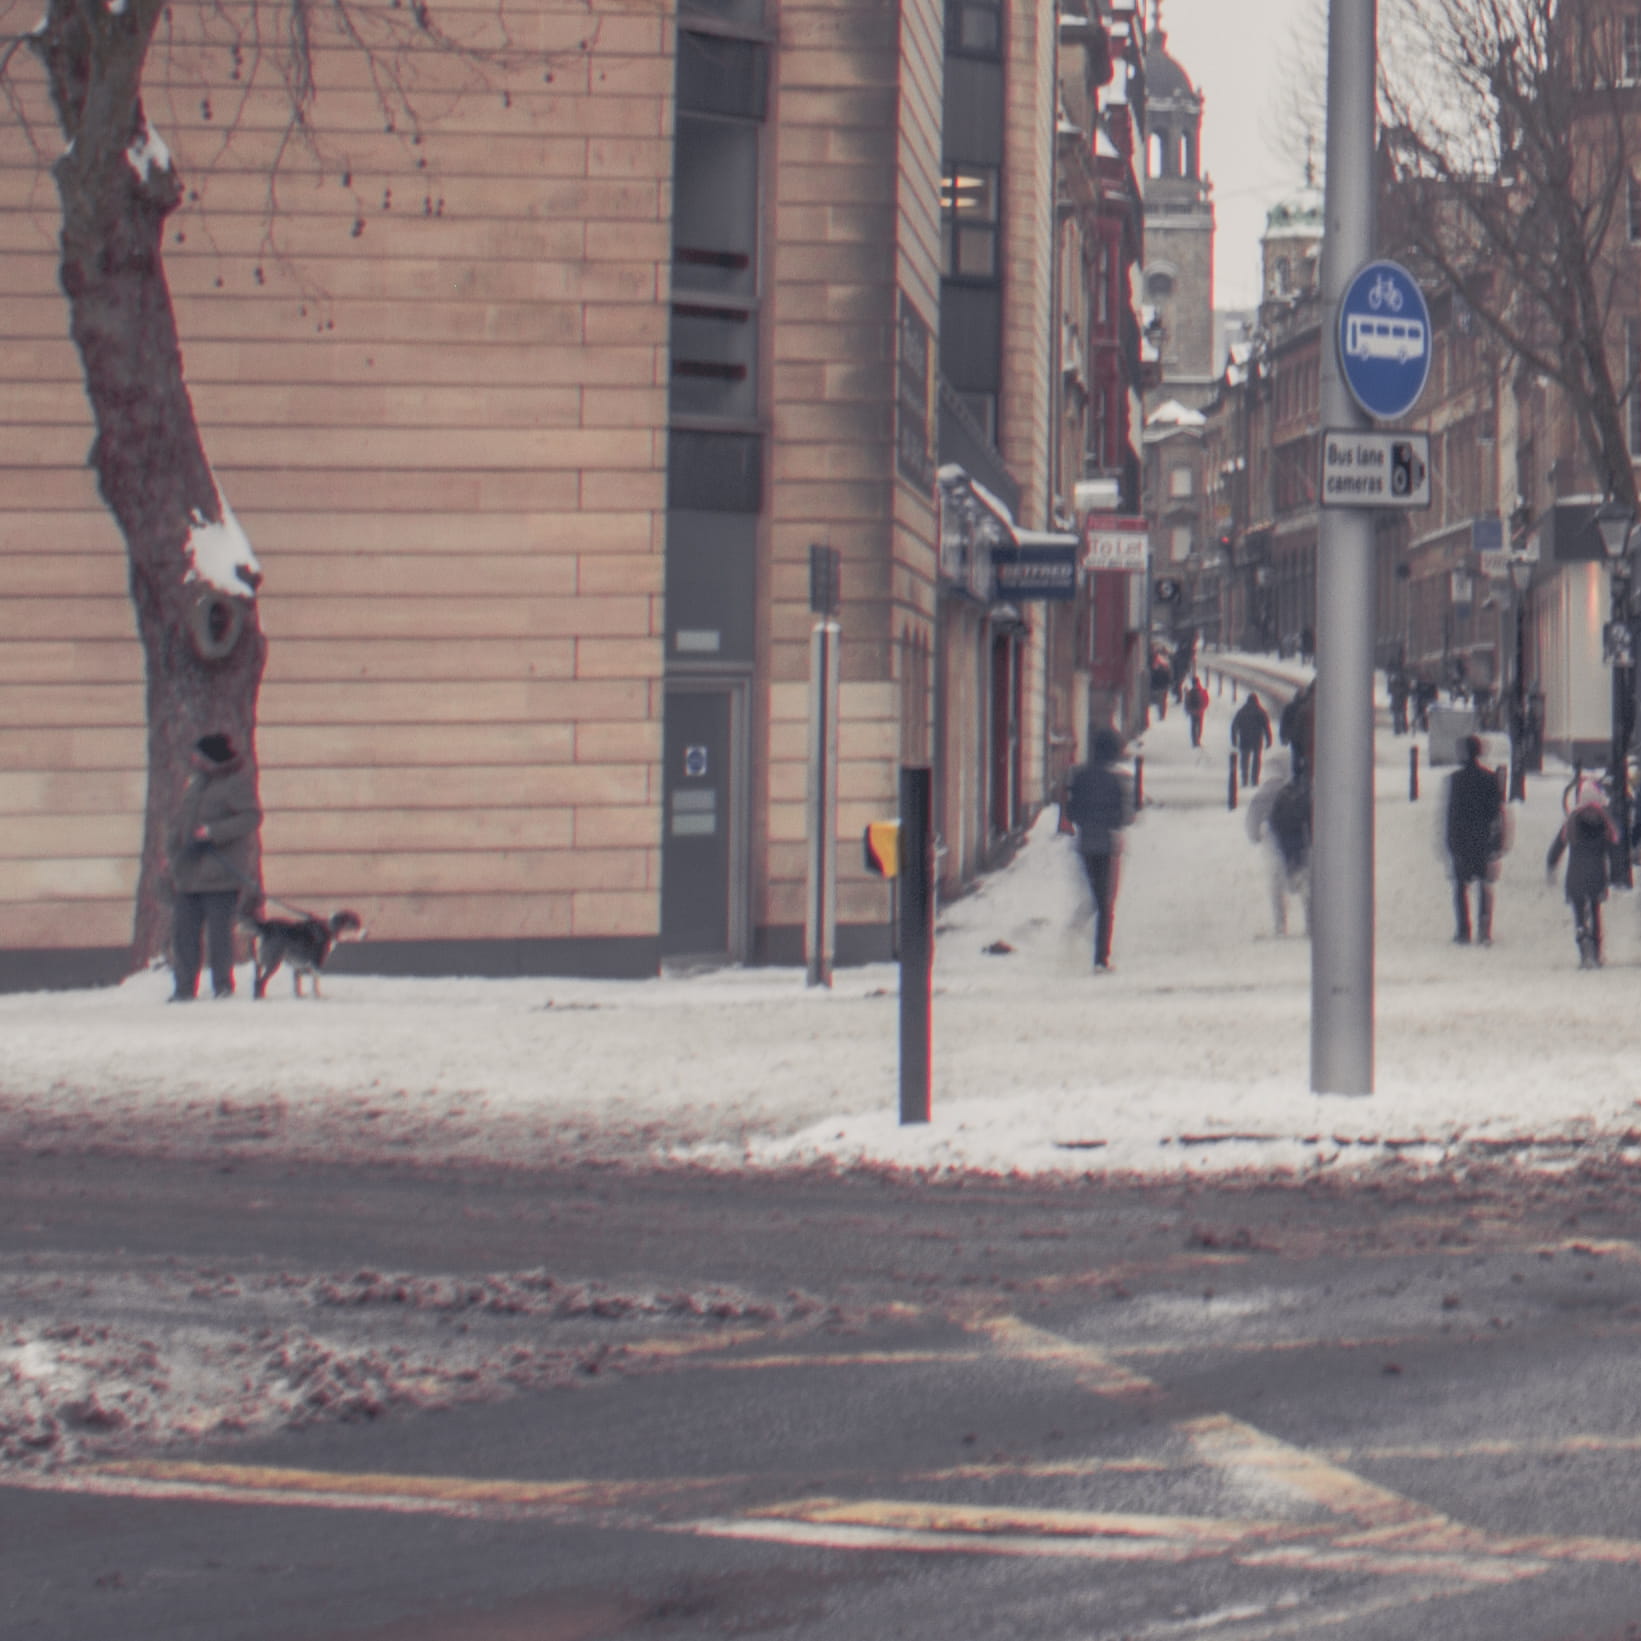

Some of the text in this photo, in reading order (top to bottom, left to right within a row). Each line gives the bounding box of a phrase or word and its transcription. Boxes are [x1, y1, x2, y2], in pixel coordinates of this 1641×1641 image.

[1327, 443, 1385, 467] Bus lane
[1327, 475, 1384, 494] cameras
